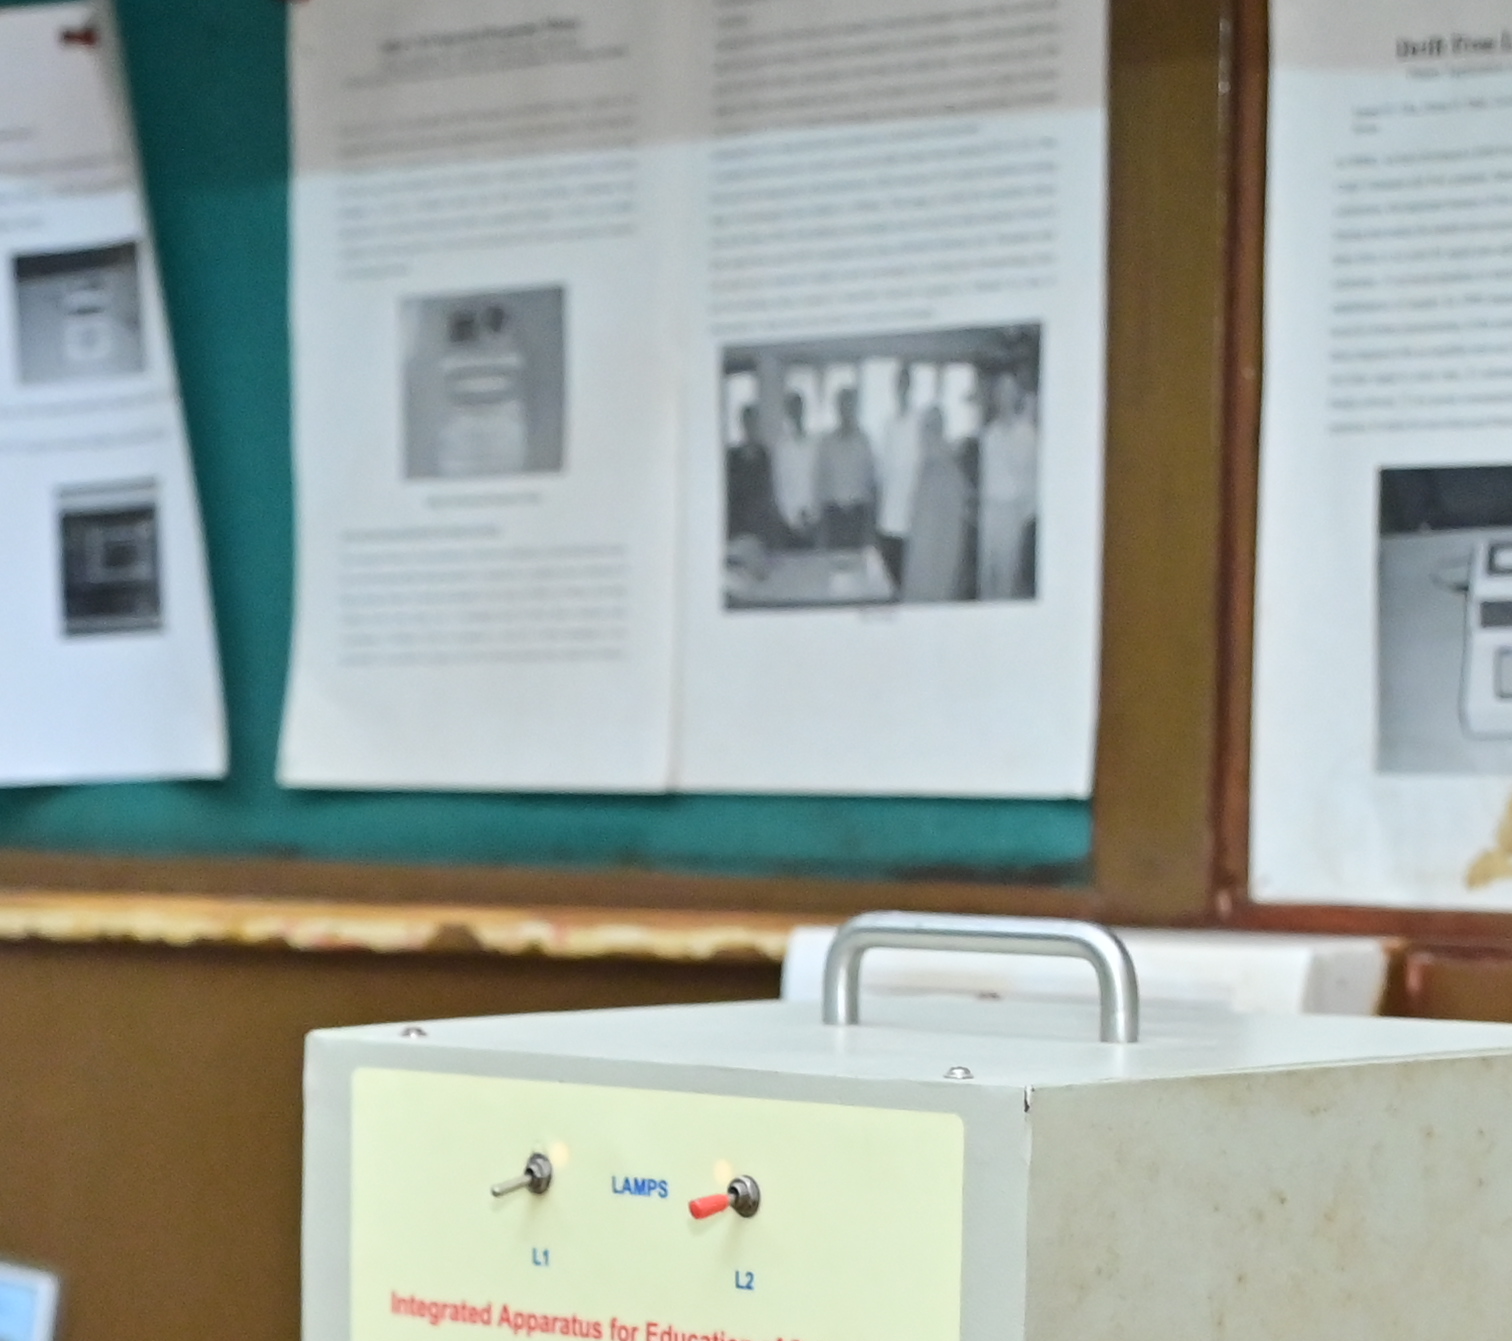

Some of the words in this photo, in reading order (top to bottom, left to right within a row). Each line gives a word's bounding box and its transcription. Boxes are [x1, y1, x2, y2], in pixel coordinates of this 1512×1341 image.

[612, 1175, 668, 1199] LAMPS
[532, 1248, 549, 1267] L1
[735, 1270, 754, 1291] L2
[391, 1290, 492, 1326] Integrated
[498, 1303, 603, 1340] Apparatus
